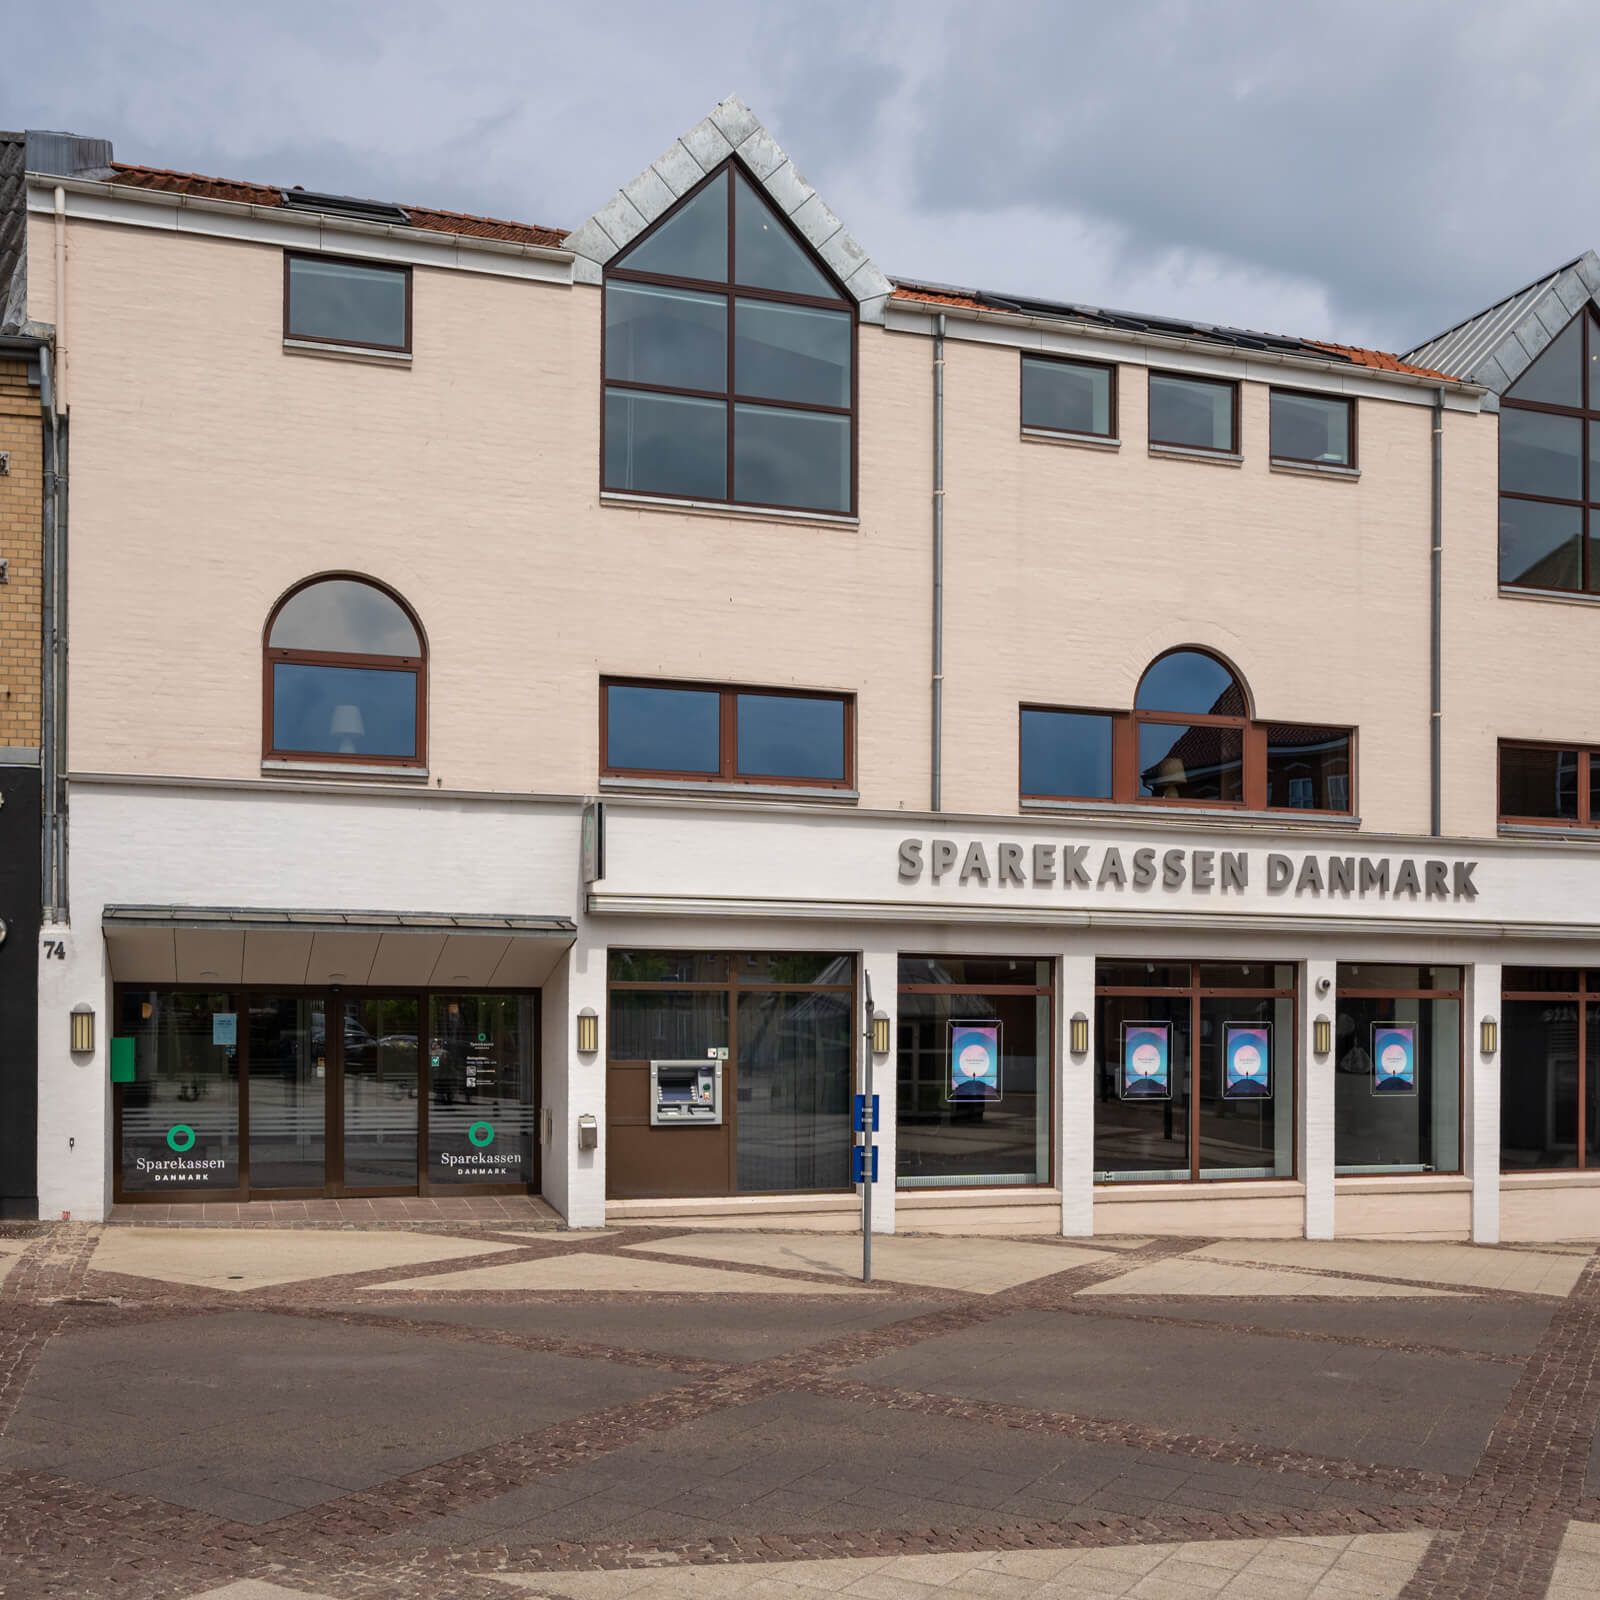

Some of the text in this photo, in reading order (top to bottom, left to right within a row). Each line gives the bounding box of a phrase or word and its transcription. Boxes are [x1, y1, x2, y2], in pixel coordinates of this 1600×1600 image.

[898, 838, 1480, 897] SPAREKASSEN DANMARK
[43, 941, 66, 960] 74
[136, 1157, 225, 1173] Sparekassen
[441, 1152, 521, 1167] Sparekassen
